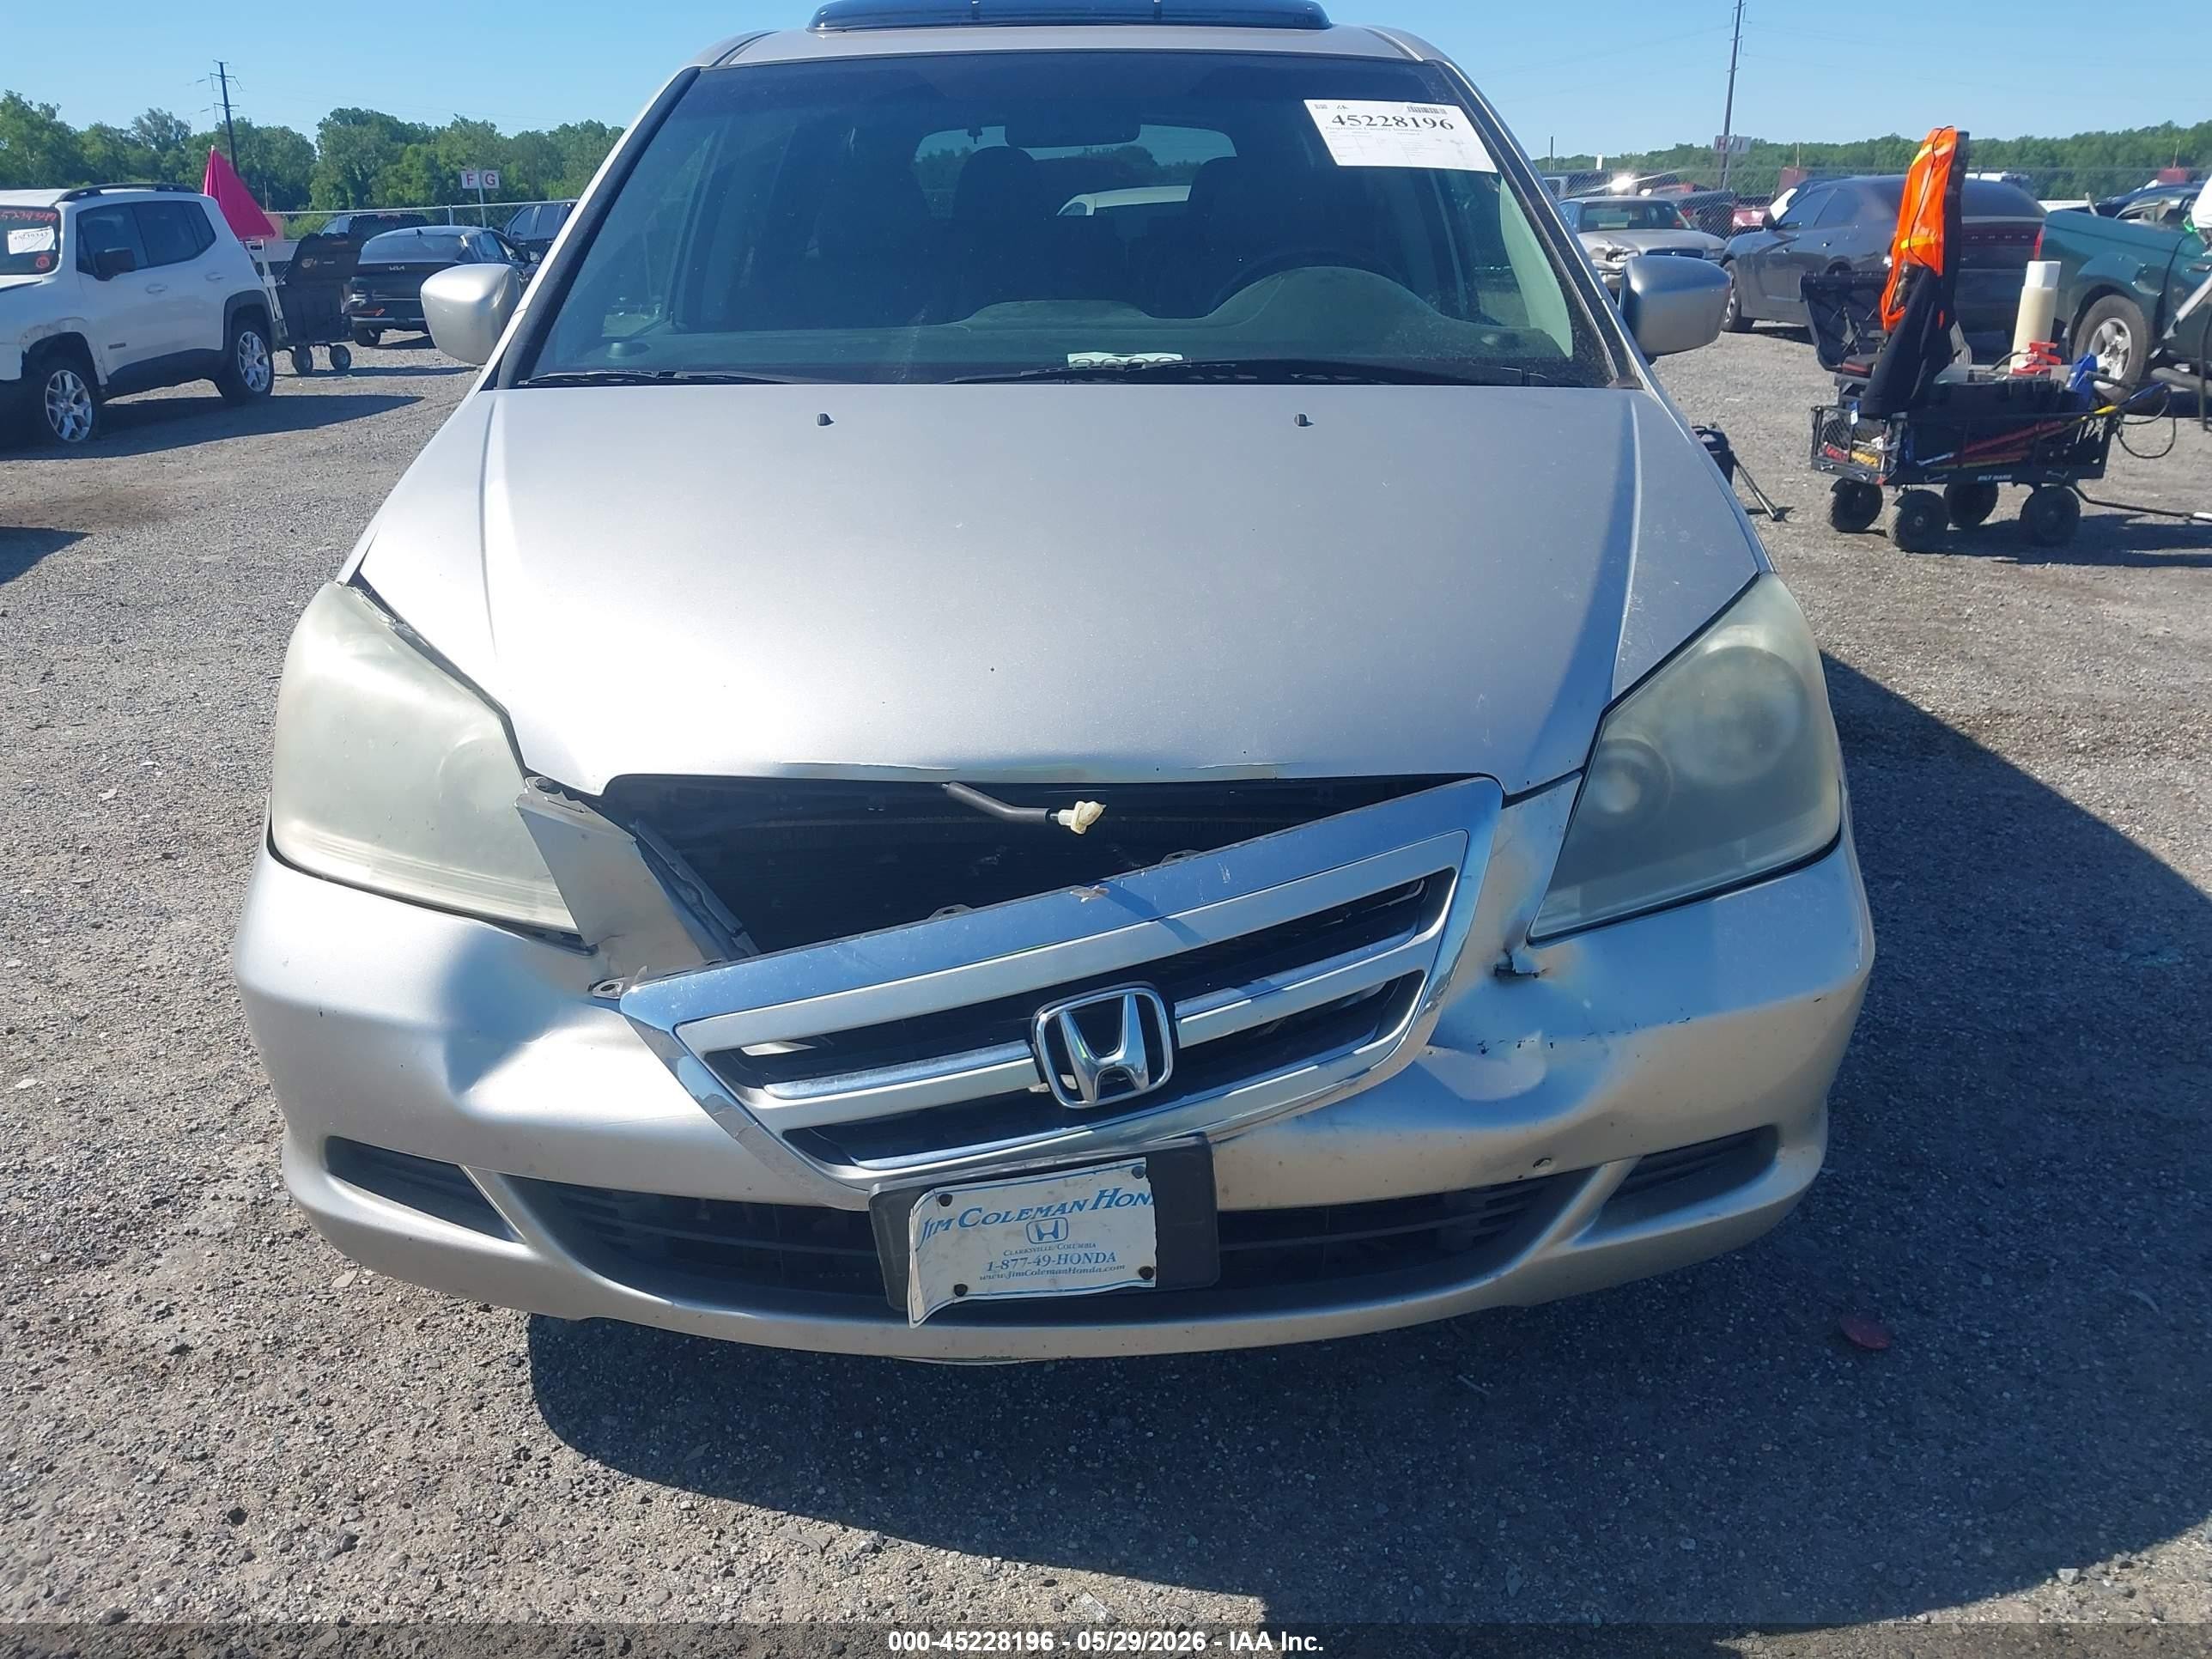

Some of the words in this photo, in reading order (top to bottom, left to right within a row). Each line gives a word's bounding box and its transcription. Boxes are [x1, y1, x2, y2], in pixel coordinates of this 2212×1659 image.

[1331, 113, 1455, 131] 45228196
[466, 173, 474, 185] F
[485, 173, 495, 185] G
[1088, 1187, 1154, 1211] HON
[987, 1251, 1117, 1272] 1-877-49-HONDA
